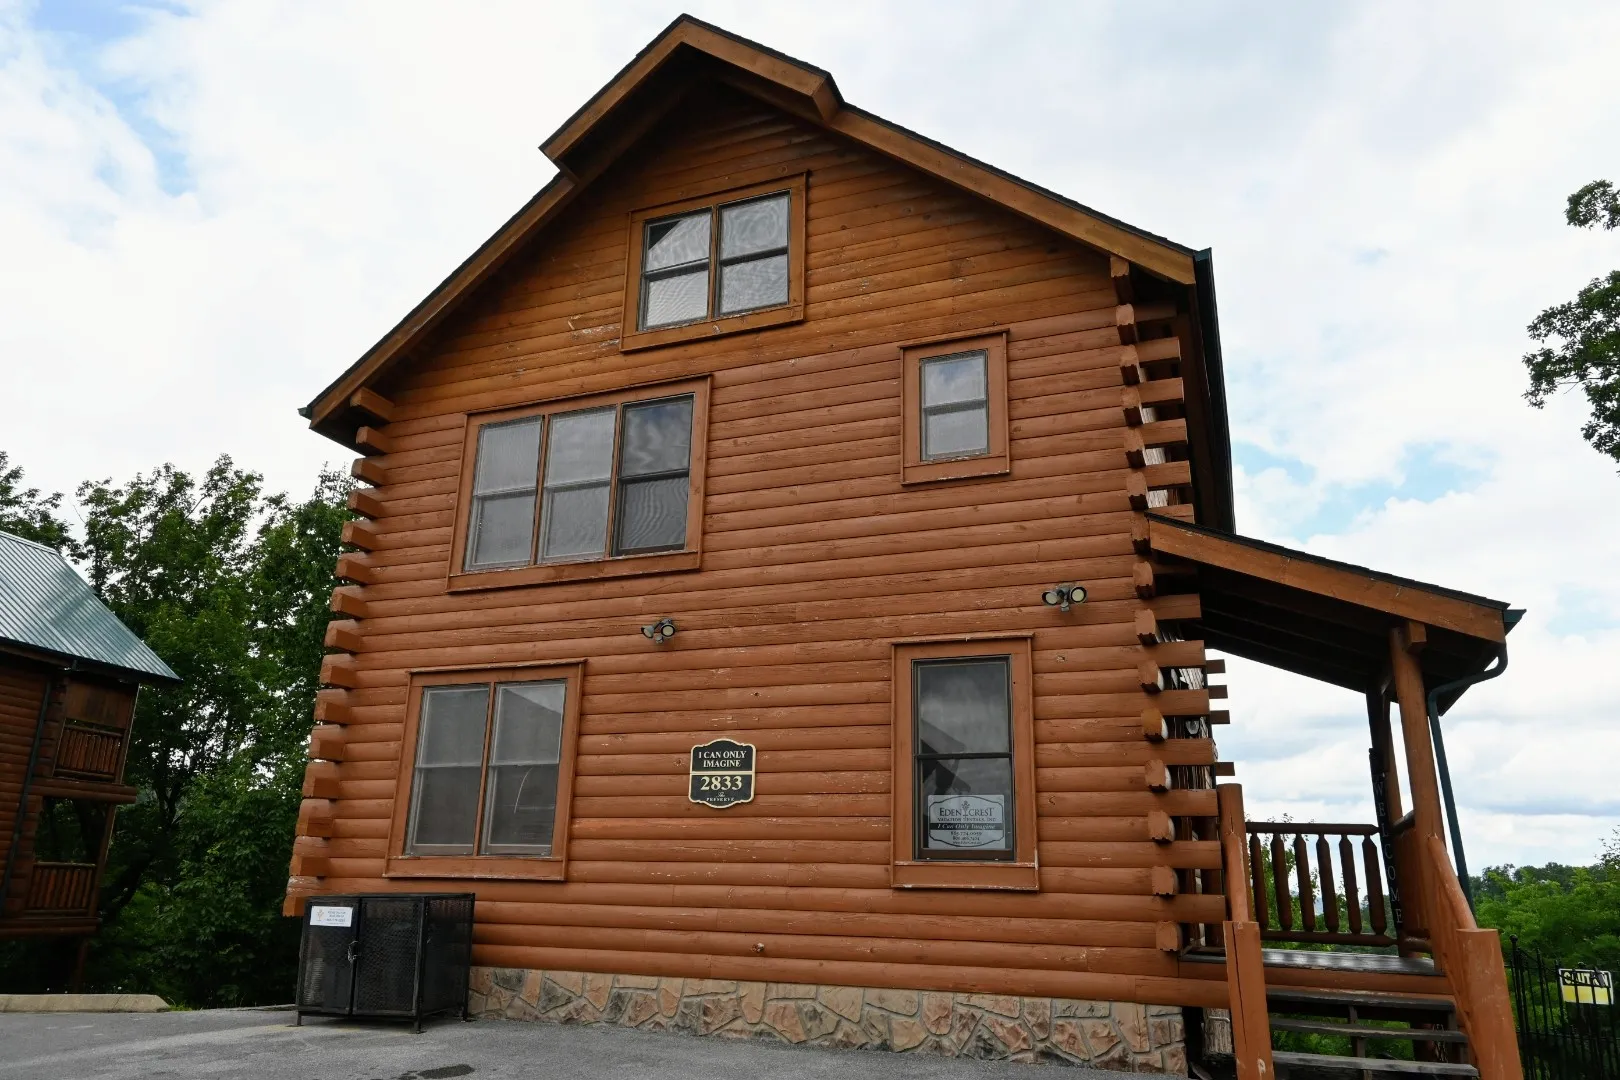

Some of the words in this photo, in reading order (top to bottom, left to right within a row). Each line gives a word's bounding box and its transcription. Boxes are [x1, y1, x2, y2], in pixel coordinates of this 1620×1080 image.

[723, 750, 746, 758] ONLY
[700, 776, 742, 790] 2833
[940, 808, 962, 816] EDEN
[968, 808, 994, 816] CREST
[1374, 780, 1403, 924] WELCOME
[1564, 972, 1610, 987] CUTN
